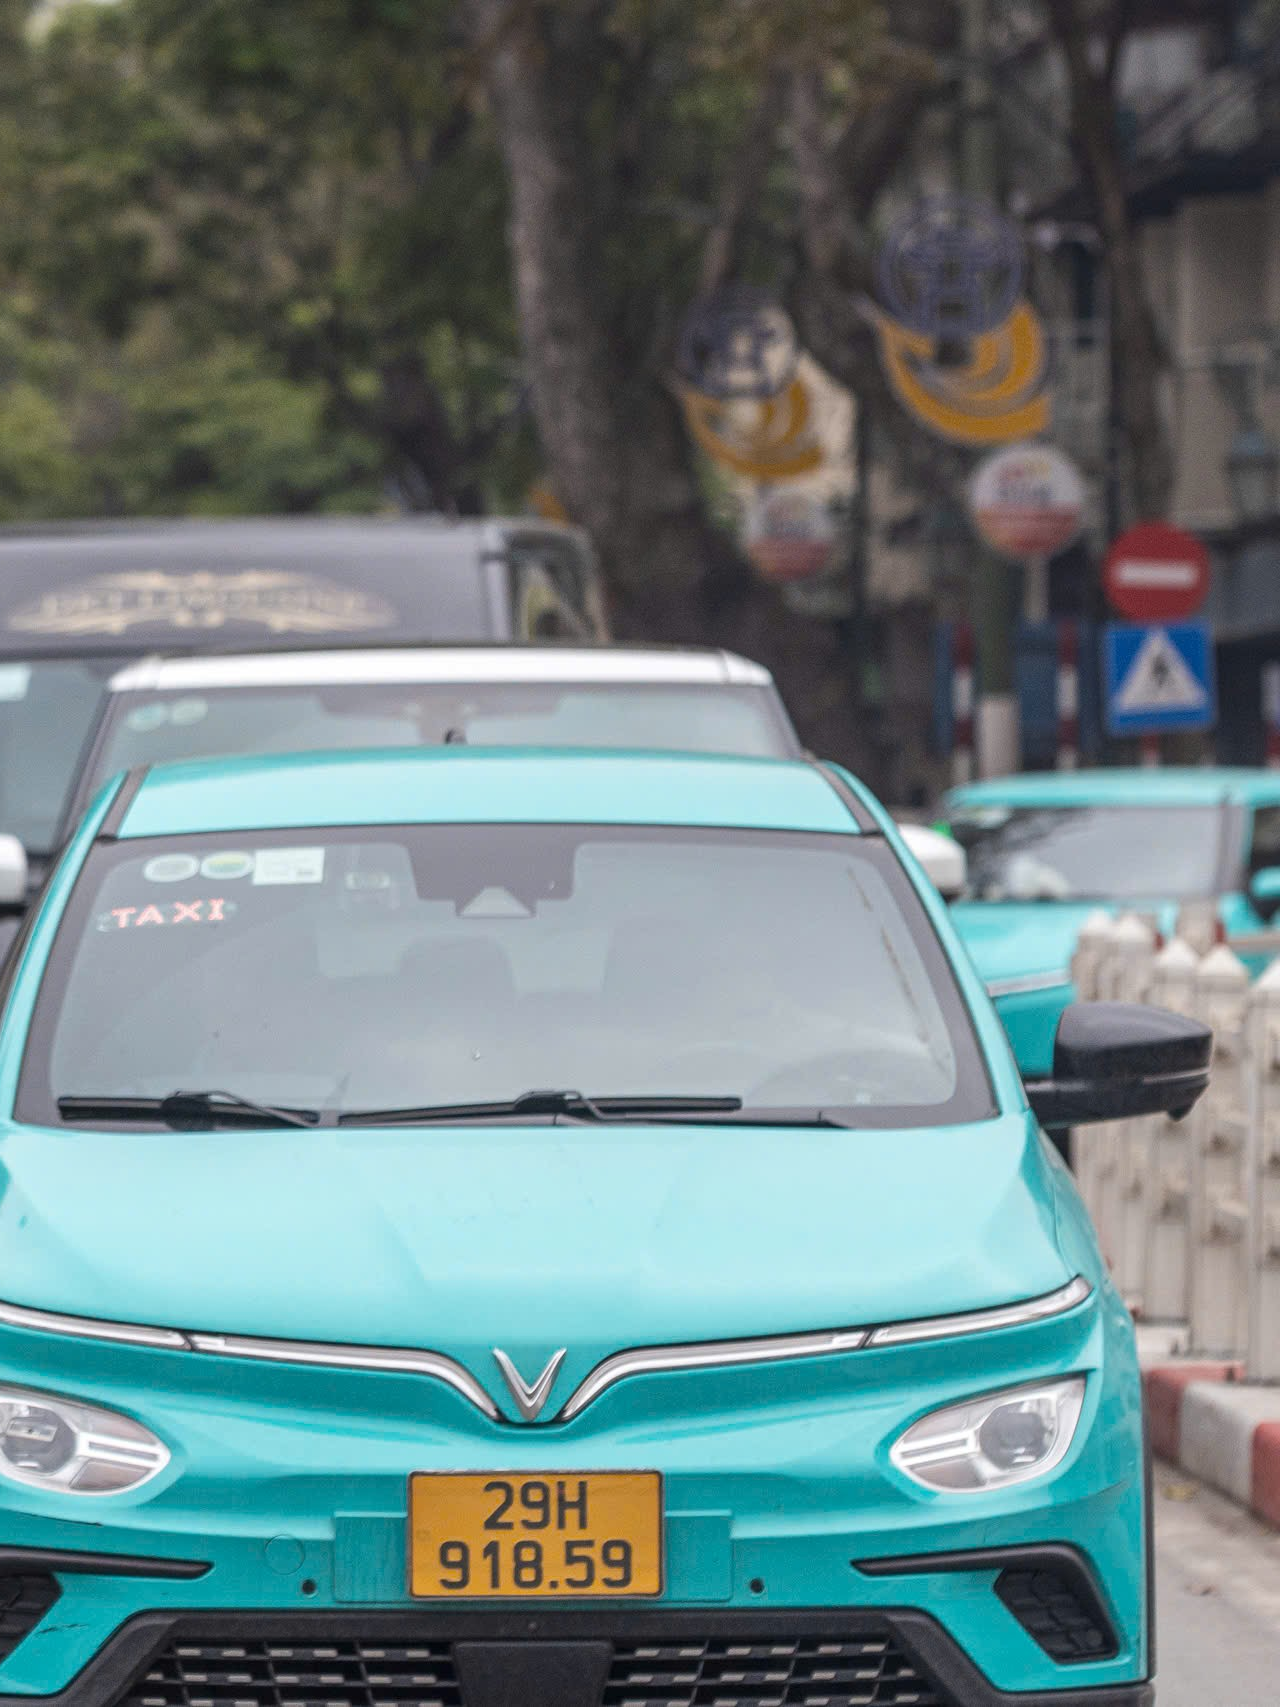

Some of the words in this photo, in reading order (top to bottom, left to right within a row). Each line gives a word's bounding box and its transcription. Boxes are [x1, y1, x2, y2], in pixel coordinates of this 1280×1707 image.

[111, 898, 224, 928] TAXI
[483, 1480, 588, 1530] 29H
[439, 1539, 632, 1590] 918.59
